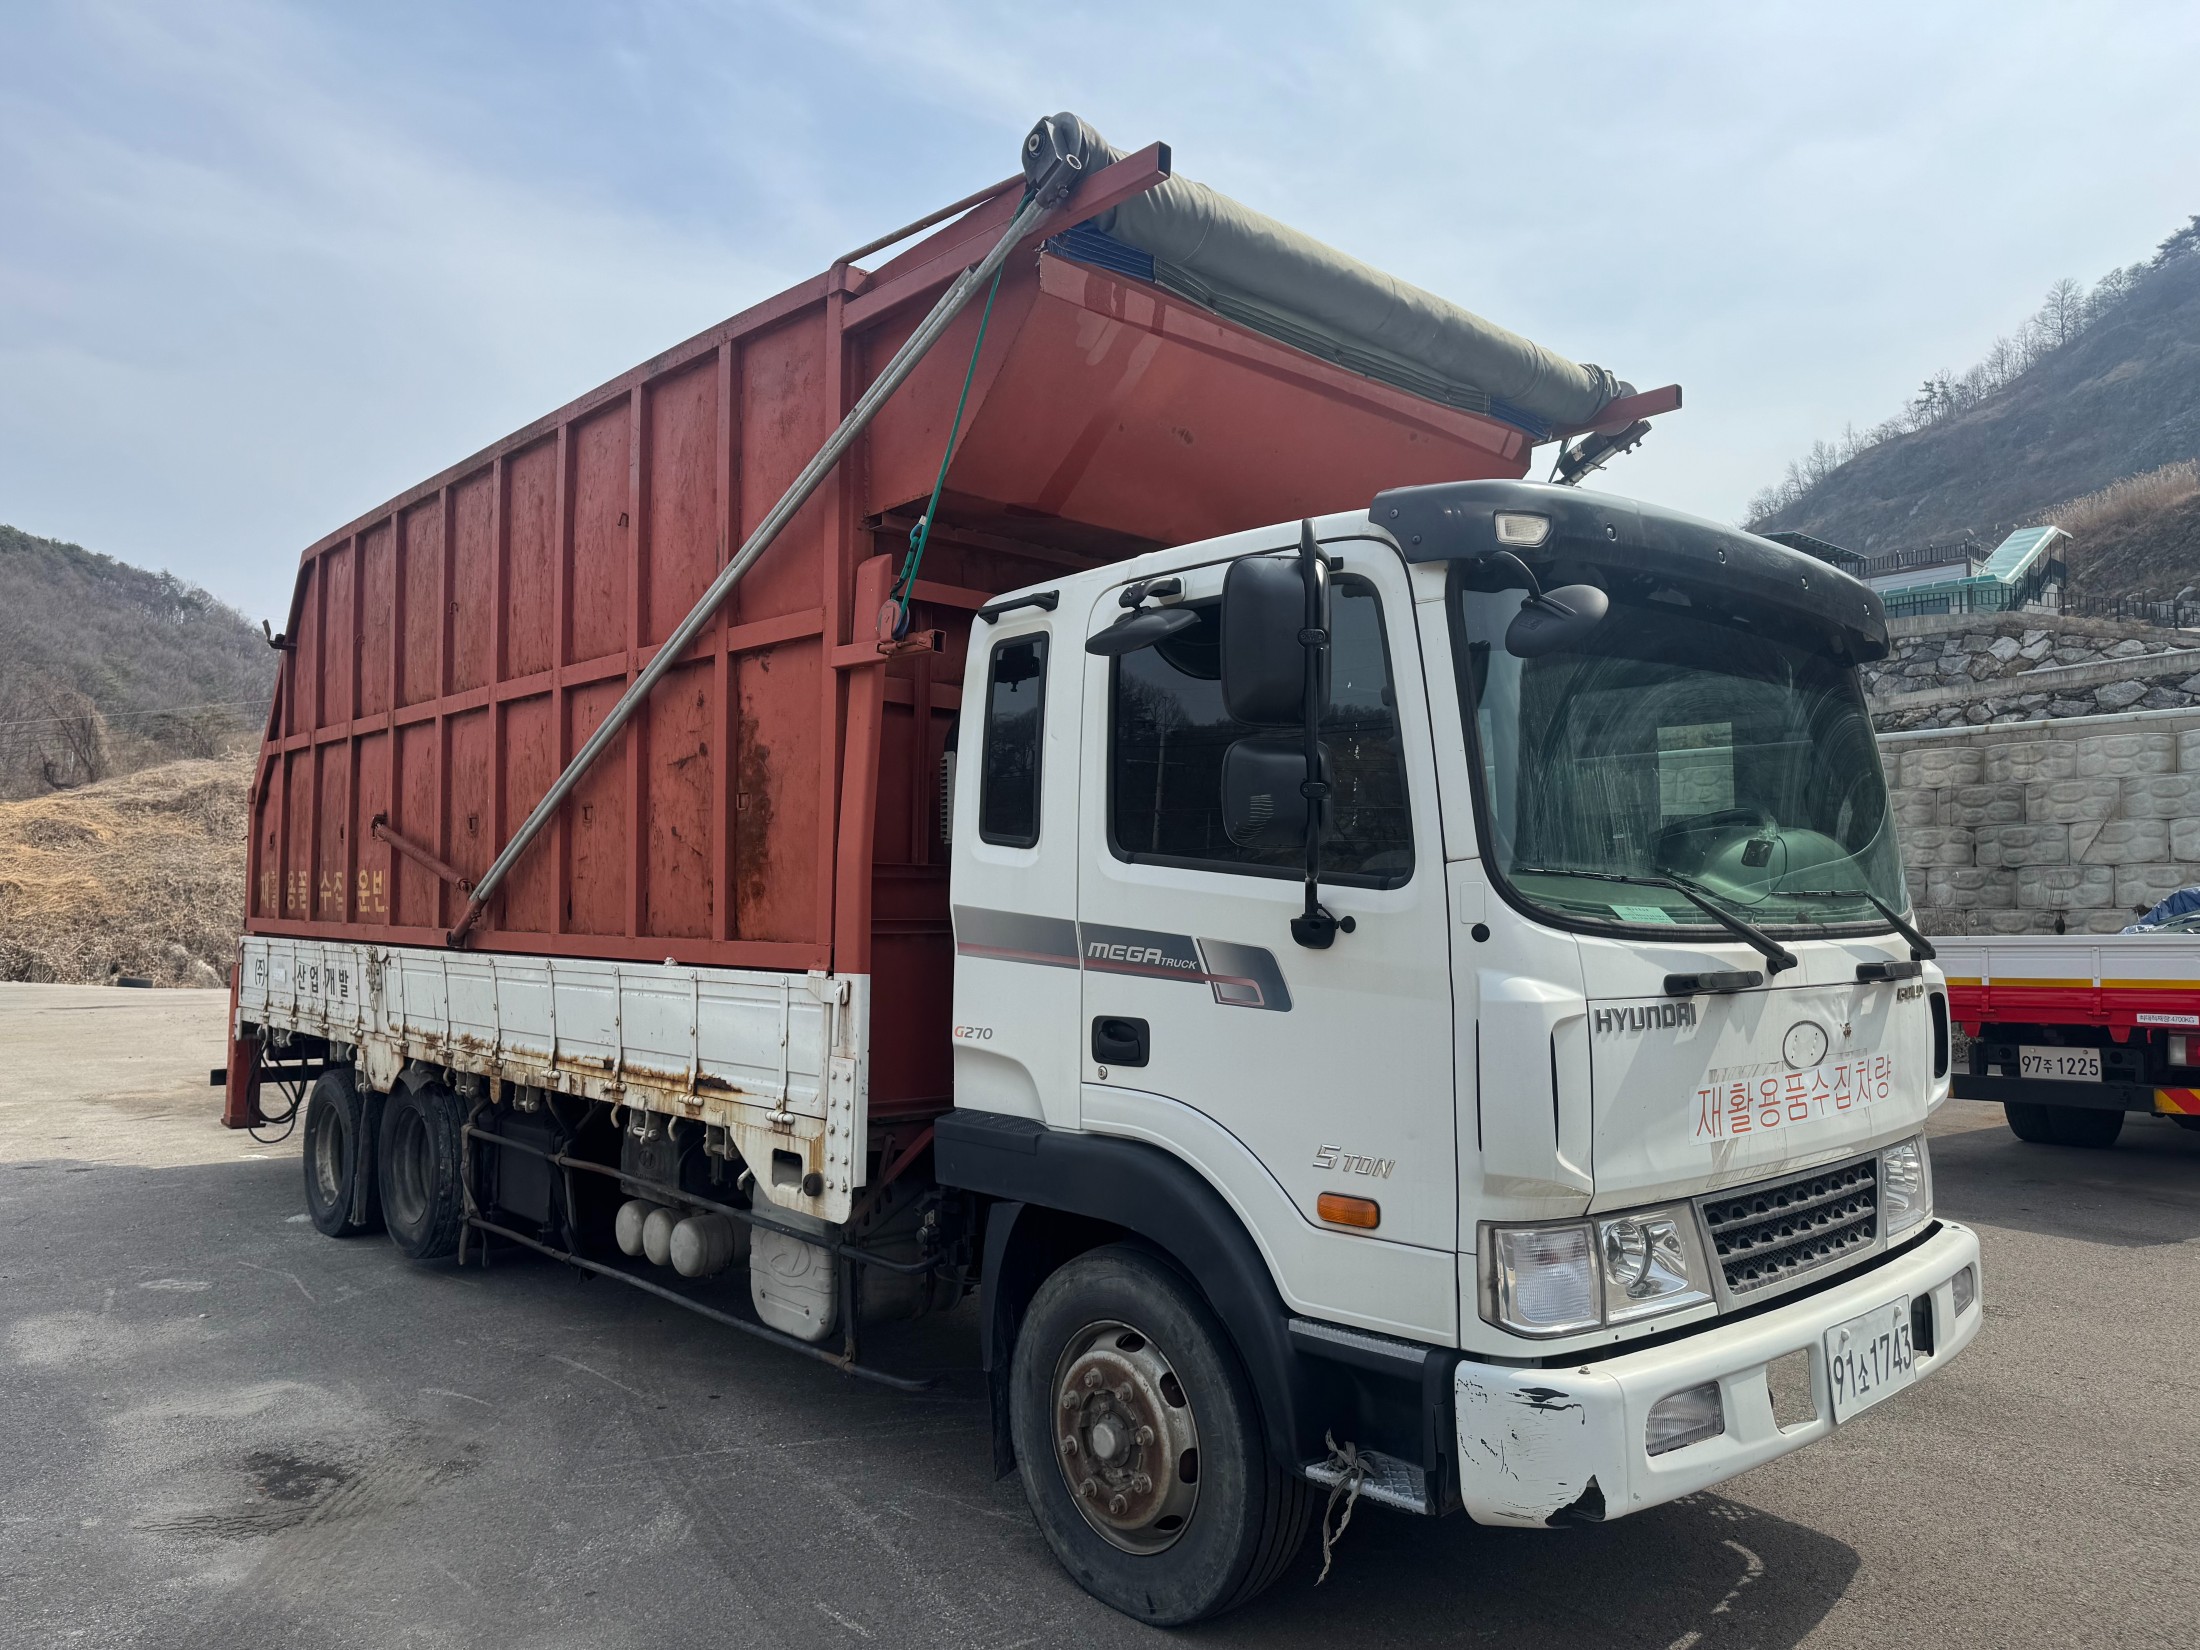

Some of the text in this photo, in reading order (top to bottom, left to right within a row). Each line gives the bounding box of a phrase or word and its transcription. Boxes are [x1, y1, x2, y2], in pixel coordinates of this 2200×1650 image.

[1087, 942, 1197, 970] MEGA TRUCK
[297, 964, 349, 998] 산업개발
[954, 1025, 993, 1040] G270
[1594, 1002, 1697, 1034] HYUNDAI
[1696, 1053, 1892, 1138] 재활용품수집차량
